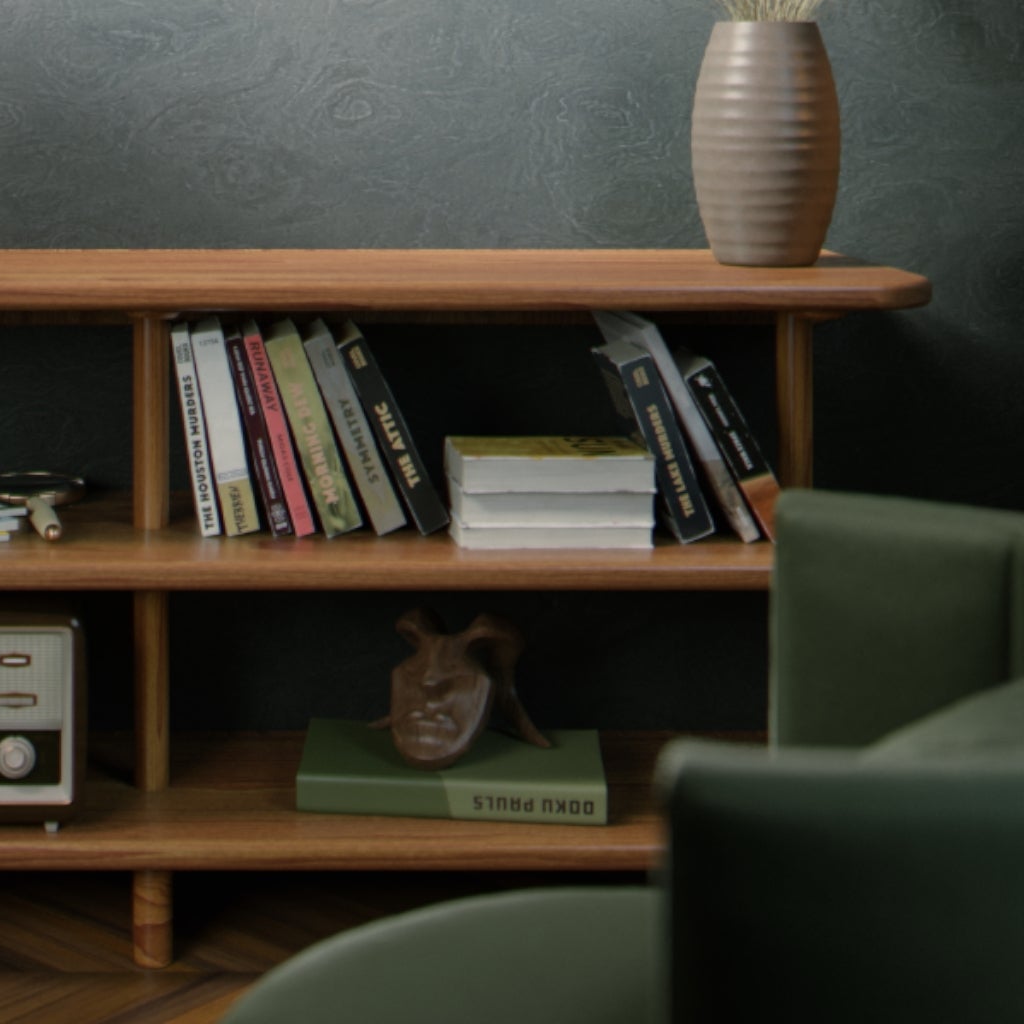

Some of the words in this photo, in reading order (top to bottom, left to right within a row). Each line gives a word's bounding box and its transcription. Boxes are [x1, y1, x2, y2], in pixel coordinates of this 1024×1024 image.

[249, 341, 279, 413] RUNAWAY
[287, 382, 312, 420] DEW
[182, 375, 201, 436] MURDERS
[374, 401, 406, 450] ATTIC
[338, 398, 380, 485] SYMMETRY
[646, 403, 675, 462] MURDERS
[192, 439, 211, 503] HOUSTON
[302, 422, 339, 505] MORNING
[398, 453, 421, 490] THE
[666, 460, 686, 494] LAKE
[202, 506, 215, 530] THE
[678, 492, 696, 520] THE
[472, 794, 535, 814] PAULS
